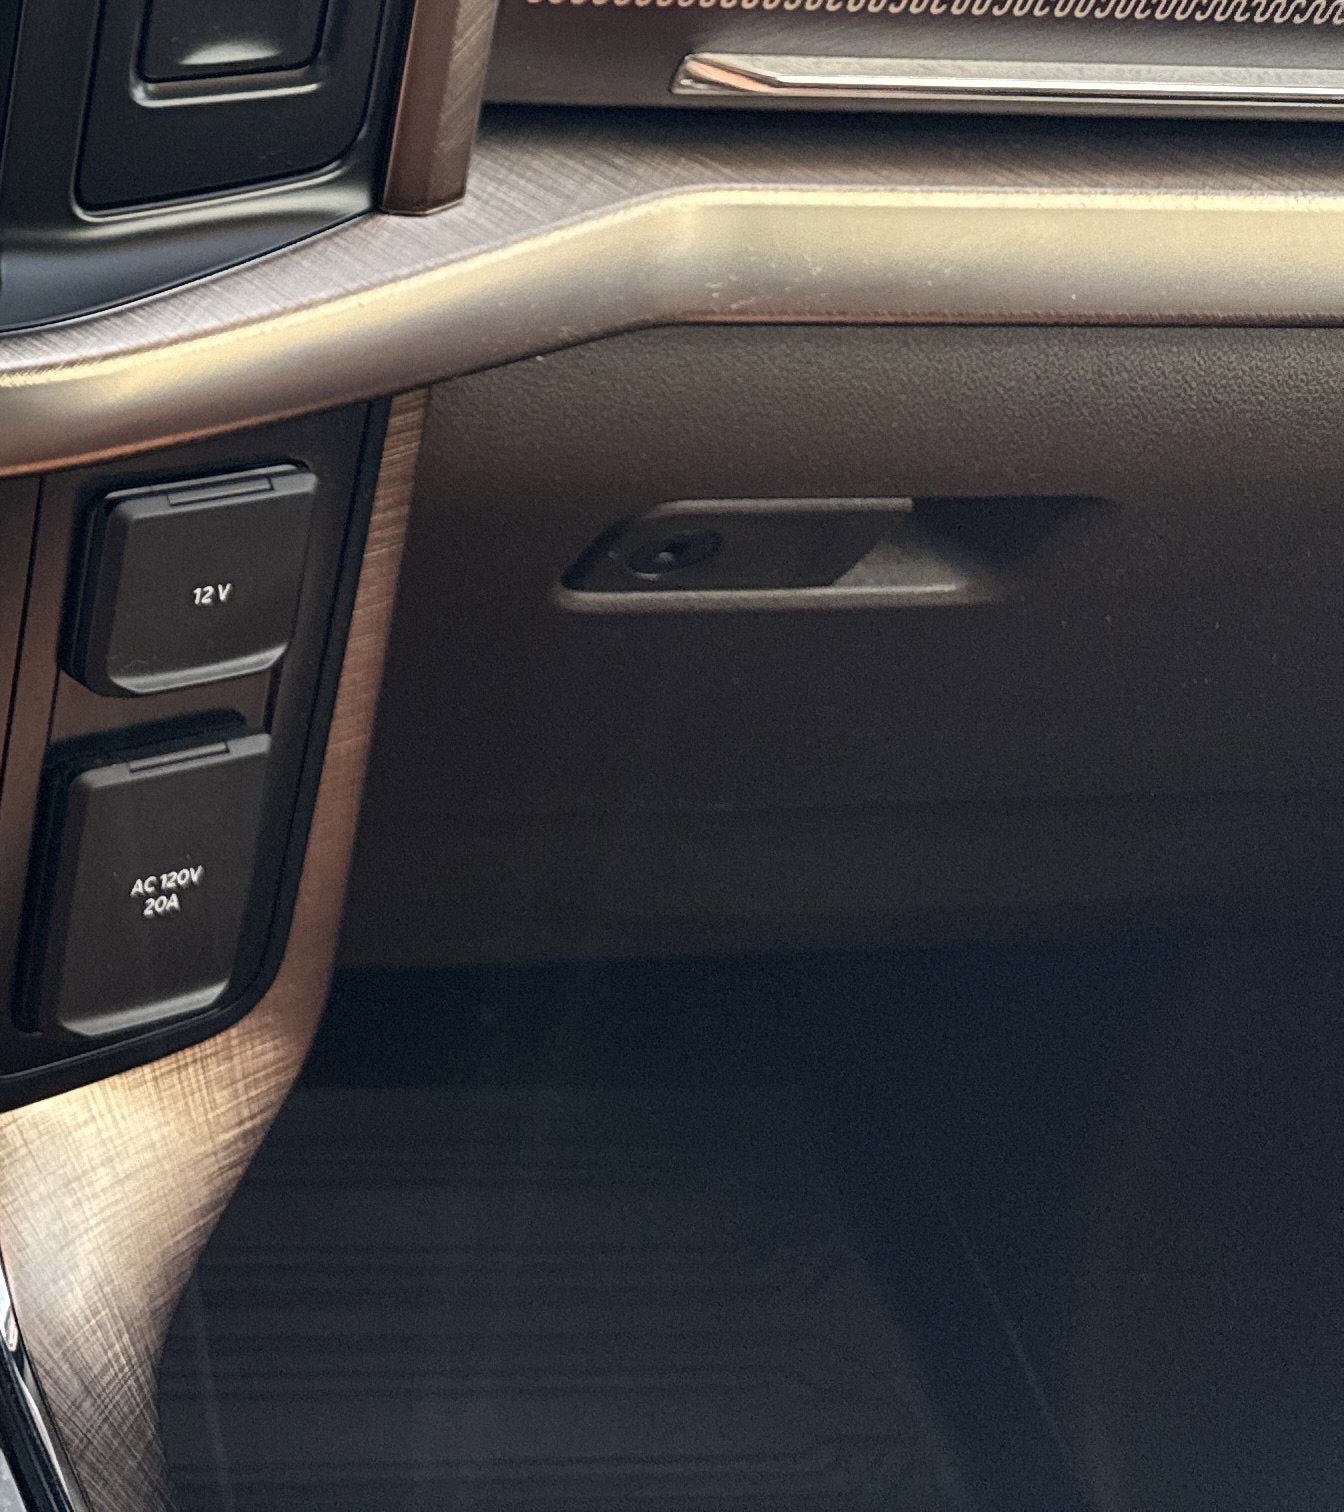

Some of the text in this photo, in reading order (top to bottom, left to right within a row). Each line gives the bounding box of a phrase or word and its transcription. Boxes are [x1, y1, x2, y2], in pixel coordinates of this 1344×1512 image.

[193, 582, 232, 606] 12 V
[129, 864, 205, 899] AC 120V
[142, 892, 181, 918] 20A
